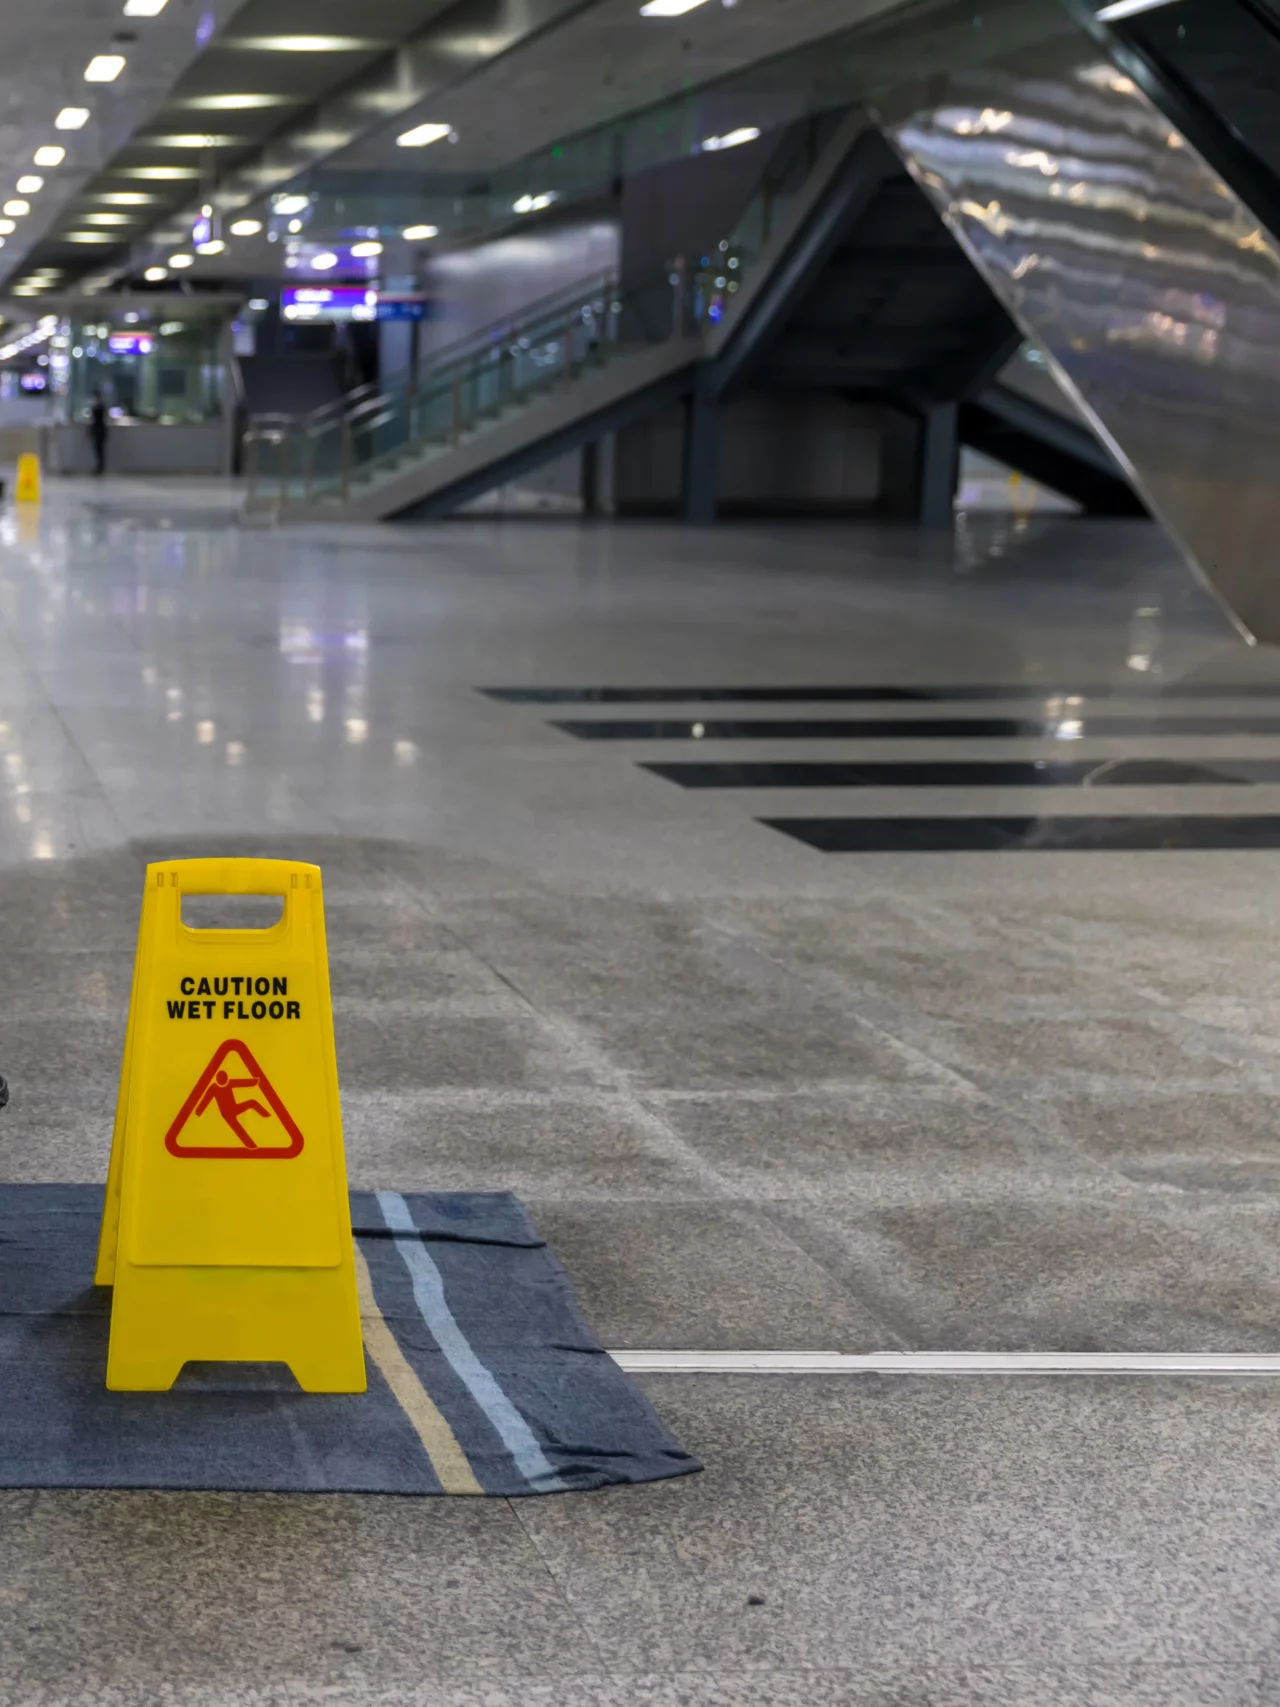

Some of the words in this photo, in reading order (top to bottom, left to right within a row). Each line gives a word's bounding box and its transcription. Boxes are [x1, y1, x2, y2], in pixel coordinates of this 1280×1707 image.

[180, 977, 288, 996] CAUTION
[166, 1001, 216, 1019] WET
[223, 1001, 301, 1019] FLOOR
